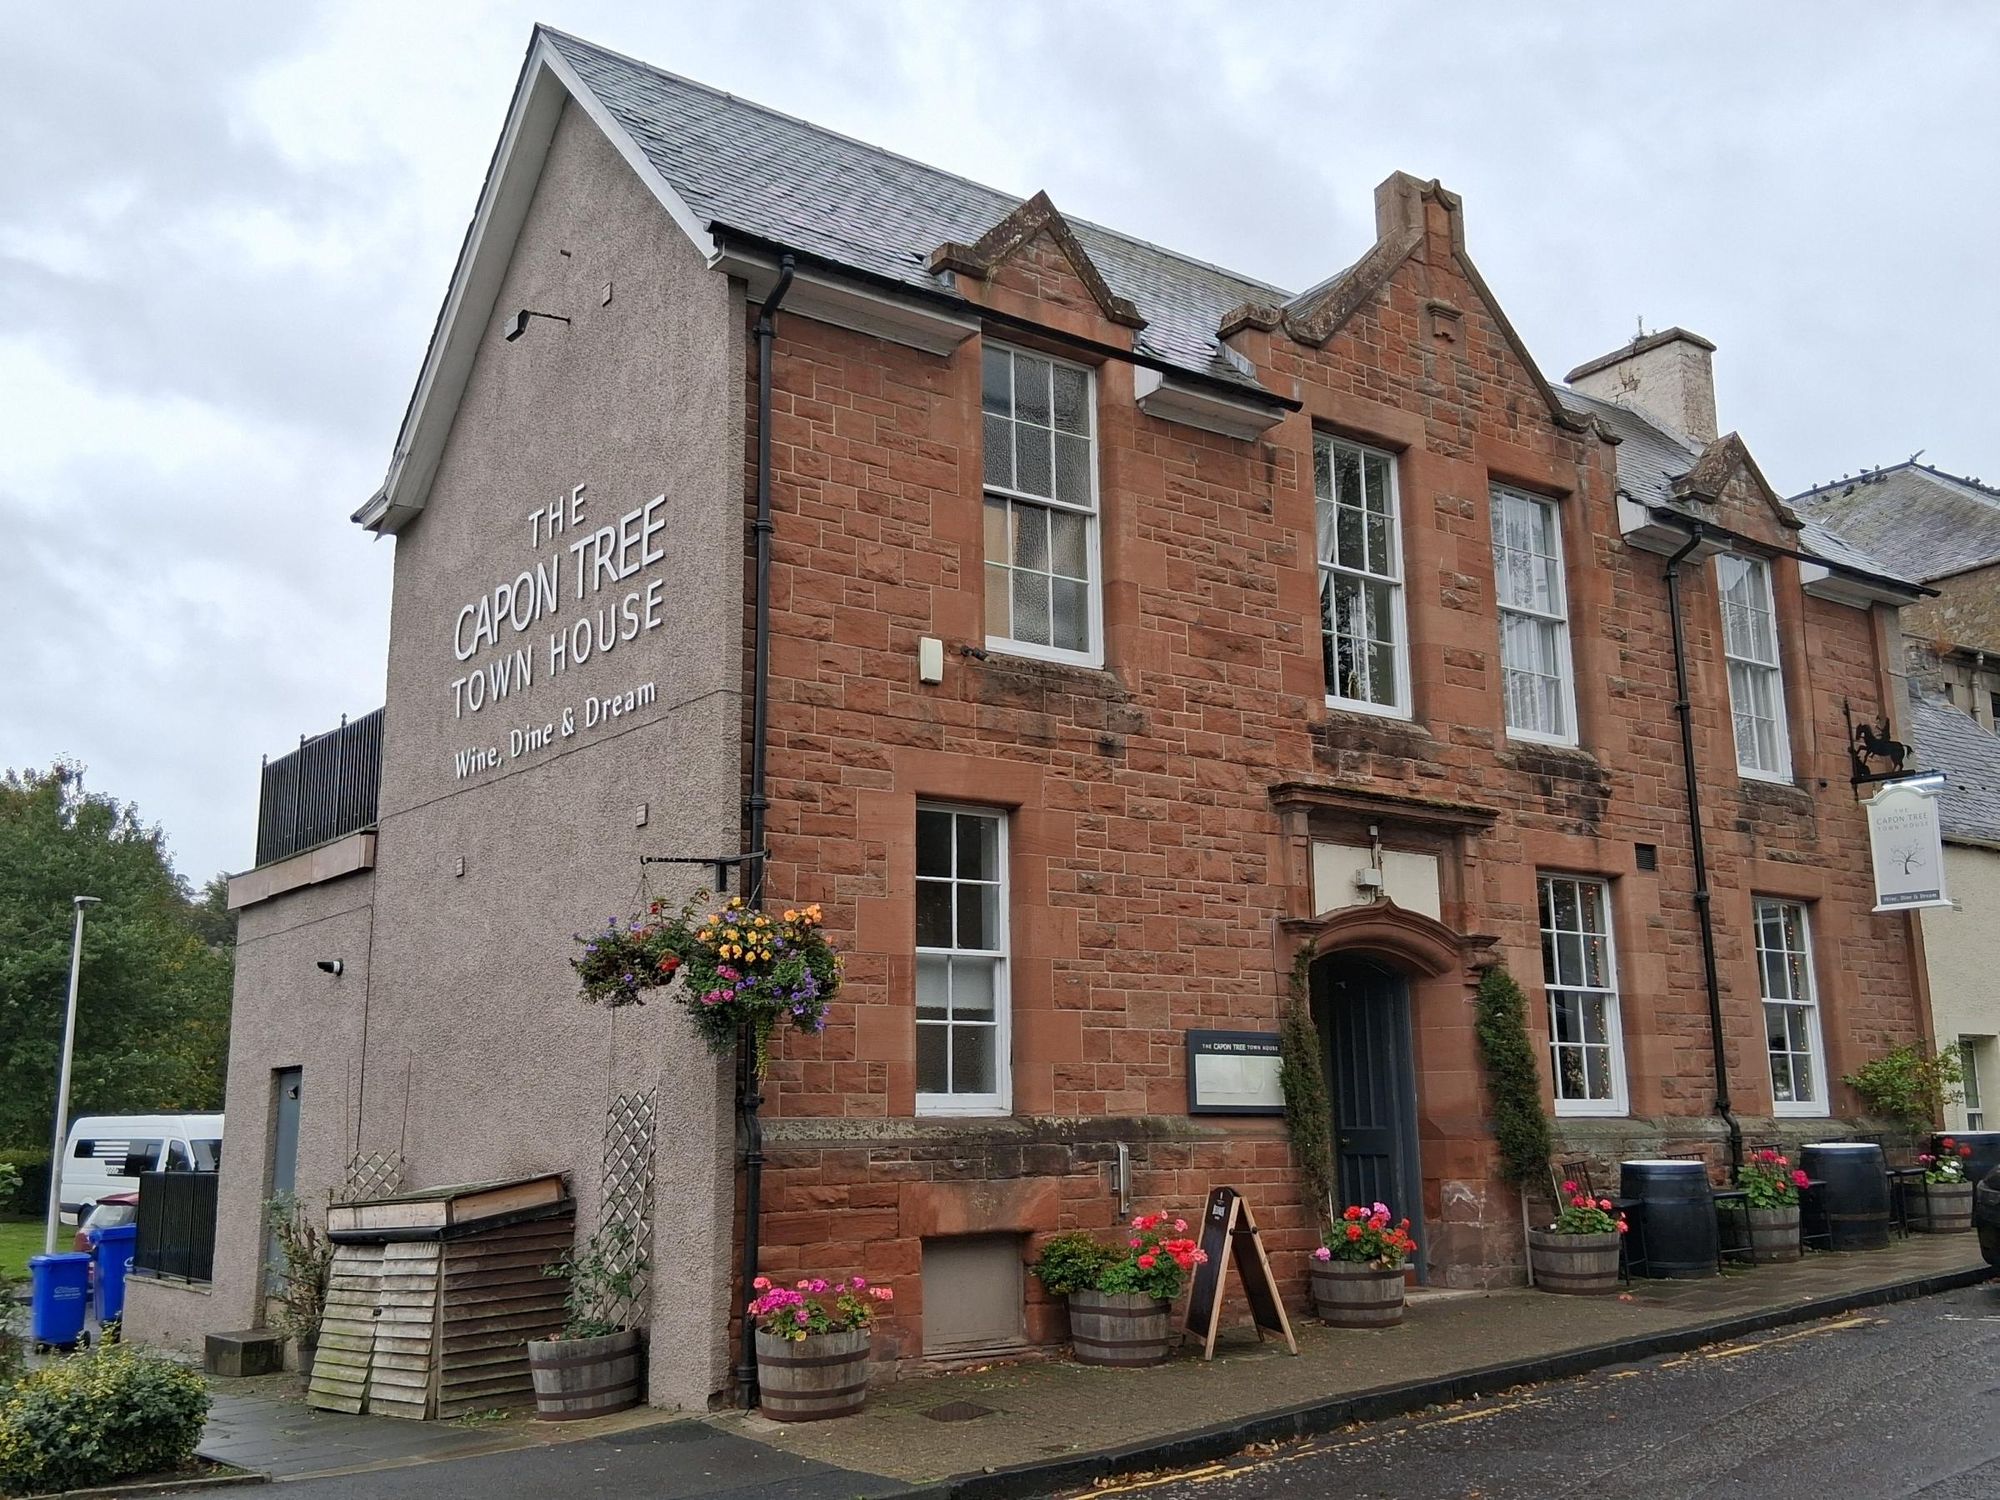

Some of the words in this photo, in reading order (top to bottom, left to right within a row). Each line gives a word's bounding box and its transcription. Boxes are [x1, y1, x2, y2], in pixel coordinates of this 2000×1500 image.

[527, 482, 586, 548] THE
[454, 553, 559, 661] CAPON
[570, 493, 665, 599] TREE
[451, 644, 532, 718] TOWN
[550, 578, 663, 675] HOUSE
[454, 746, 503, 779] Wine,
[510, 723, 553, 758] Dine
[560, 706, 575, 737] &
[585, 681, 656, 728] Dream
[1908, 813, 1928, 821] TREE
[1213, 1043, 1232, 1051] CAPON
